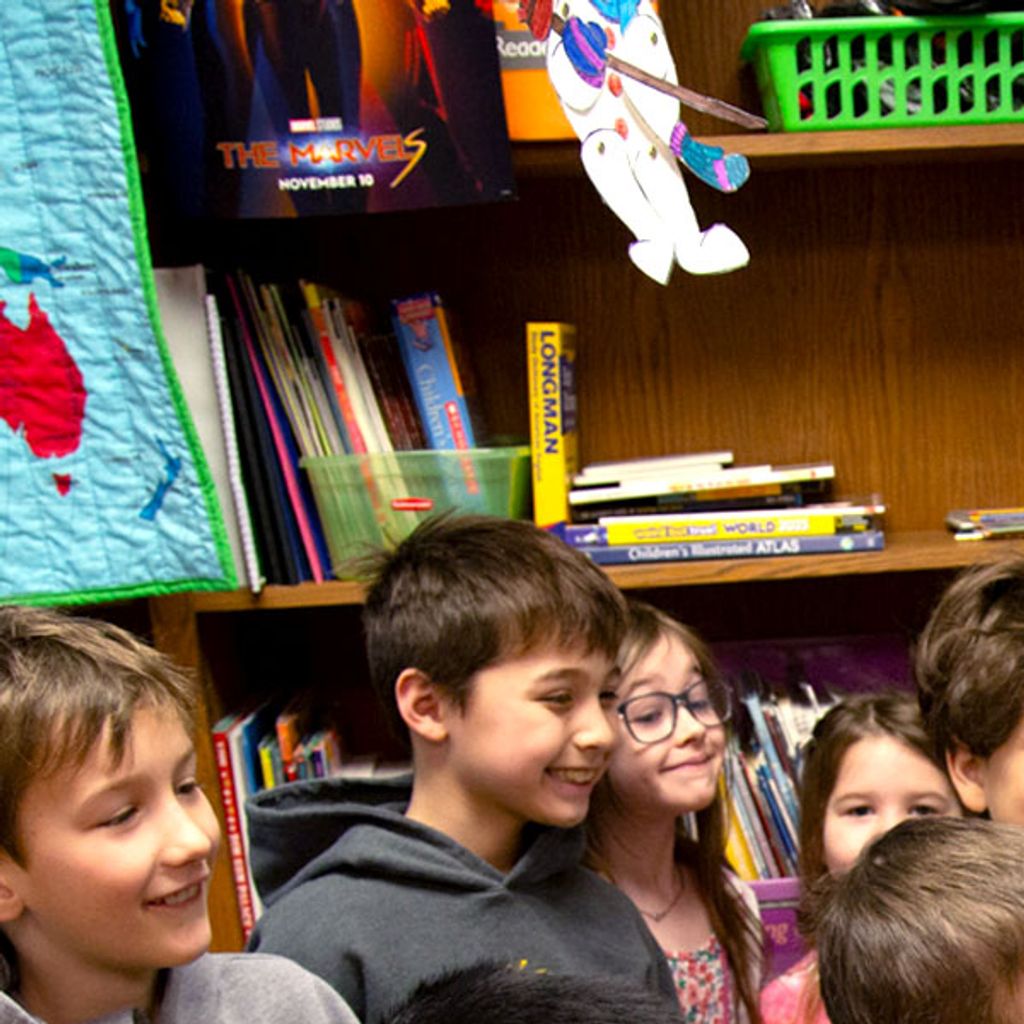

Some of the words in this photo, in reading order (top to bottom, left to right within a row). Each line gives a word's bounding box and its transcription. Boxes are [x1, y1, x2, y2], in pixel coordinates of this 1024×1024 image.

[216, 141, 280, 169] THE
[289, 128, 428, 188] MARVELS
[278, 175, 356, 191] NOVEMBER
[358, 173, 375, 187] 10
[540, 331, 559, 454] LONGMAN
[723, 520, 776, 535] WORLD
[628, 544, 689, 561] Children's
[754, 538, 800, 555] ATLAS
